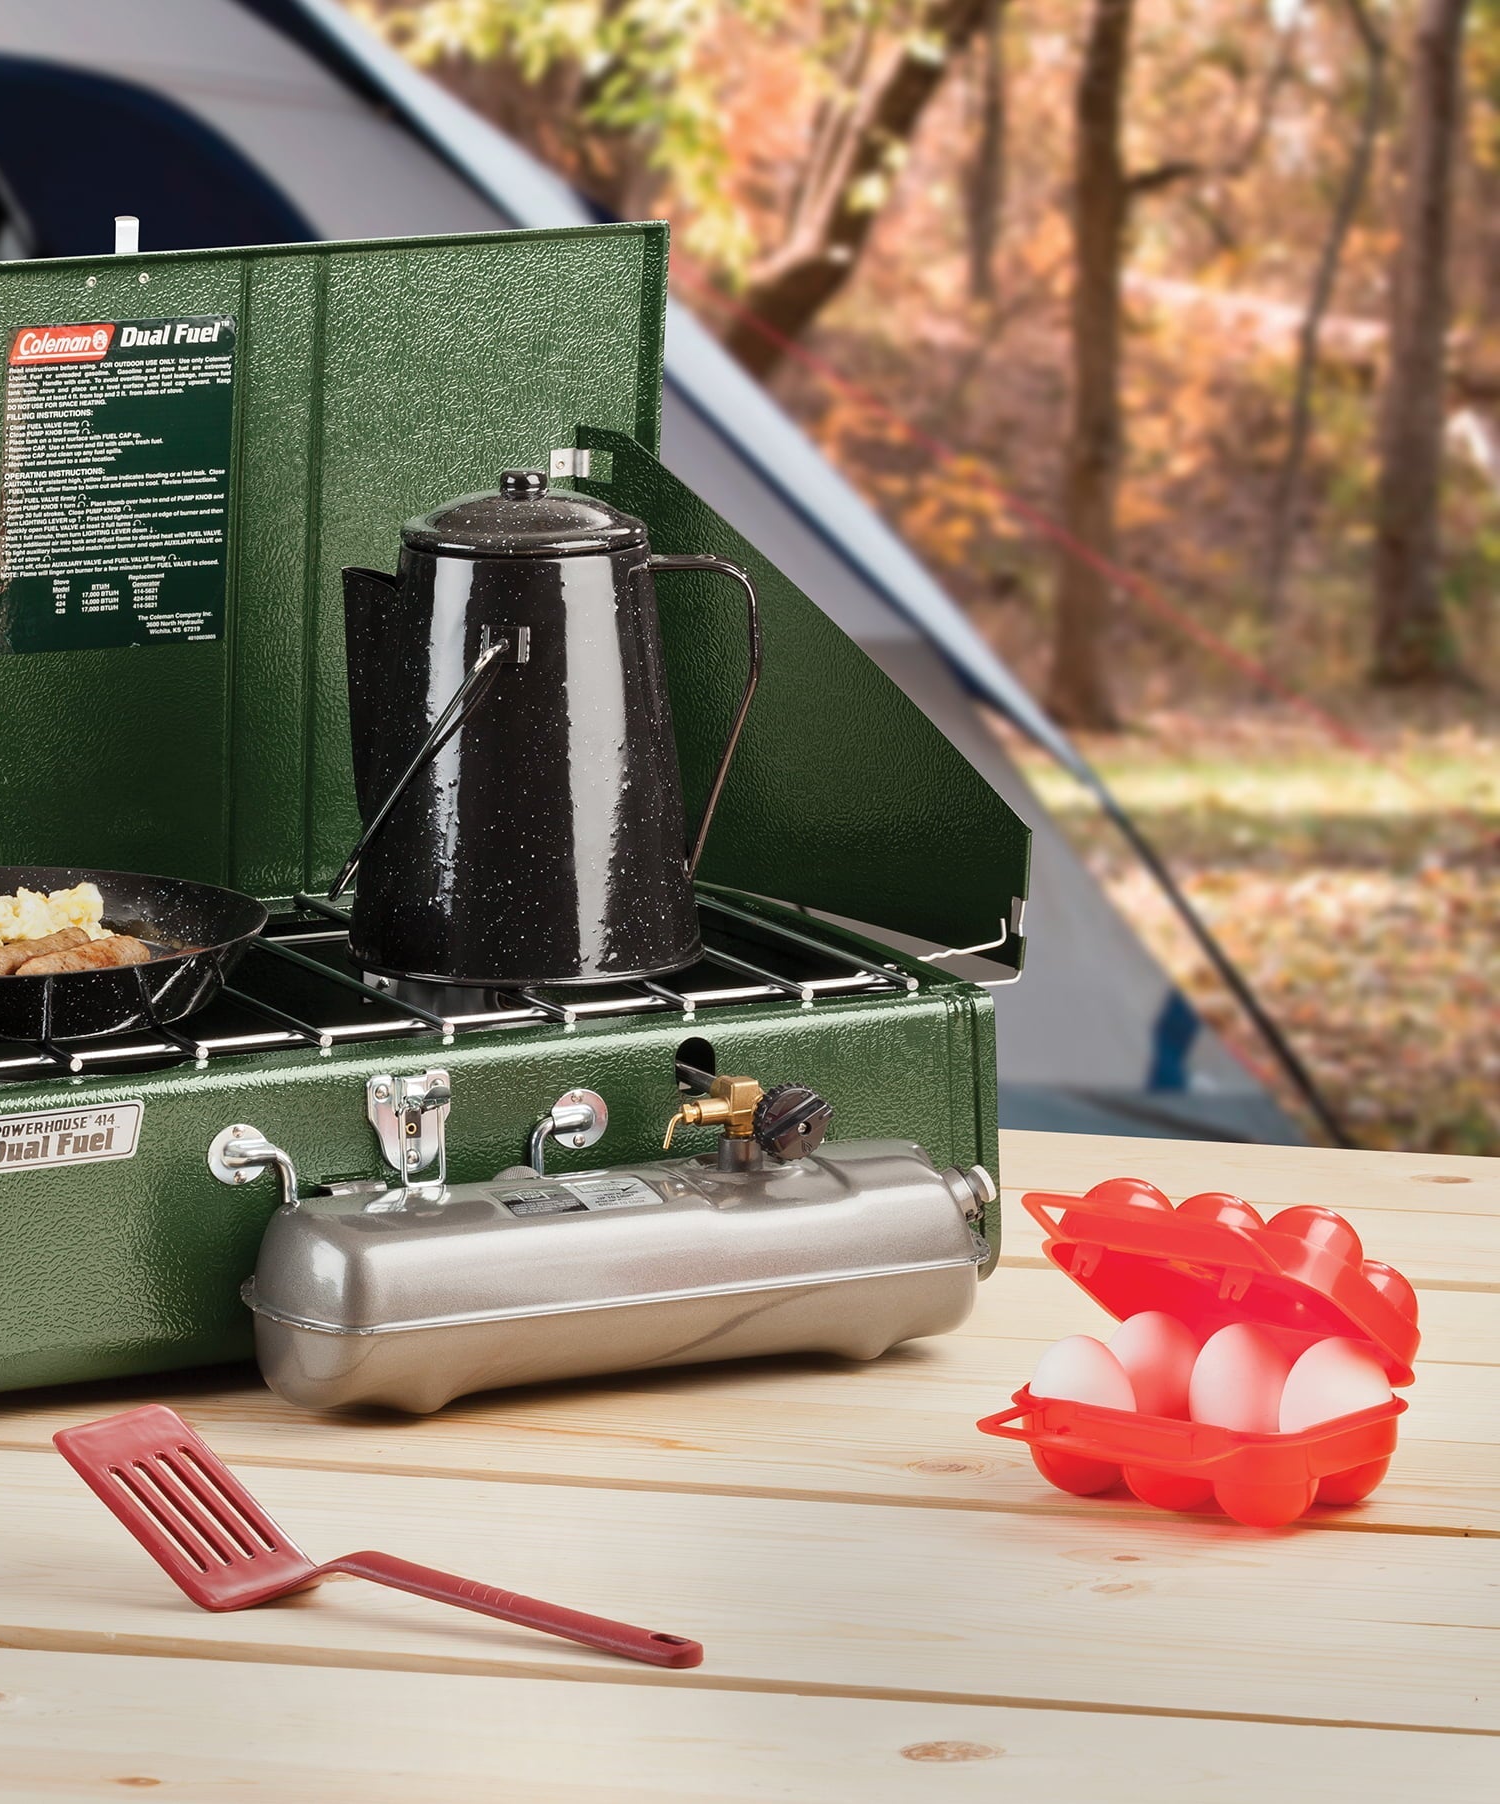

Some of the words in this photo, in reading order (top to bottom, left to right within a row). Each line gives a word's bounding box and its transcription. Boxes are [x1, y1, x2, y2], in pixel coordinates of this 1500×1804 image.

[20, 332, 90, 356] Coleman
[120, 325, 168, 347] Dual
[79, 398, 107, 406] HEATING.
[7, 411, 35, 420] FILLING
[36, 408, 93, 419] INSTRUCTIONS:
[63, 420, 79, 429] firmly
[63, 428, 79, 436] firmly
[4, 470, 47, 480] OPERATING
[48, 466, 106, 477] INSTRUCTIONS:
[53, 578, 70, 586] Stove
[175, 611, 201, 619] Company
[94, 1114, 114, 1126] 414
